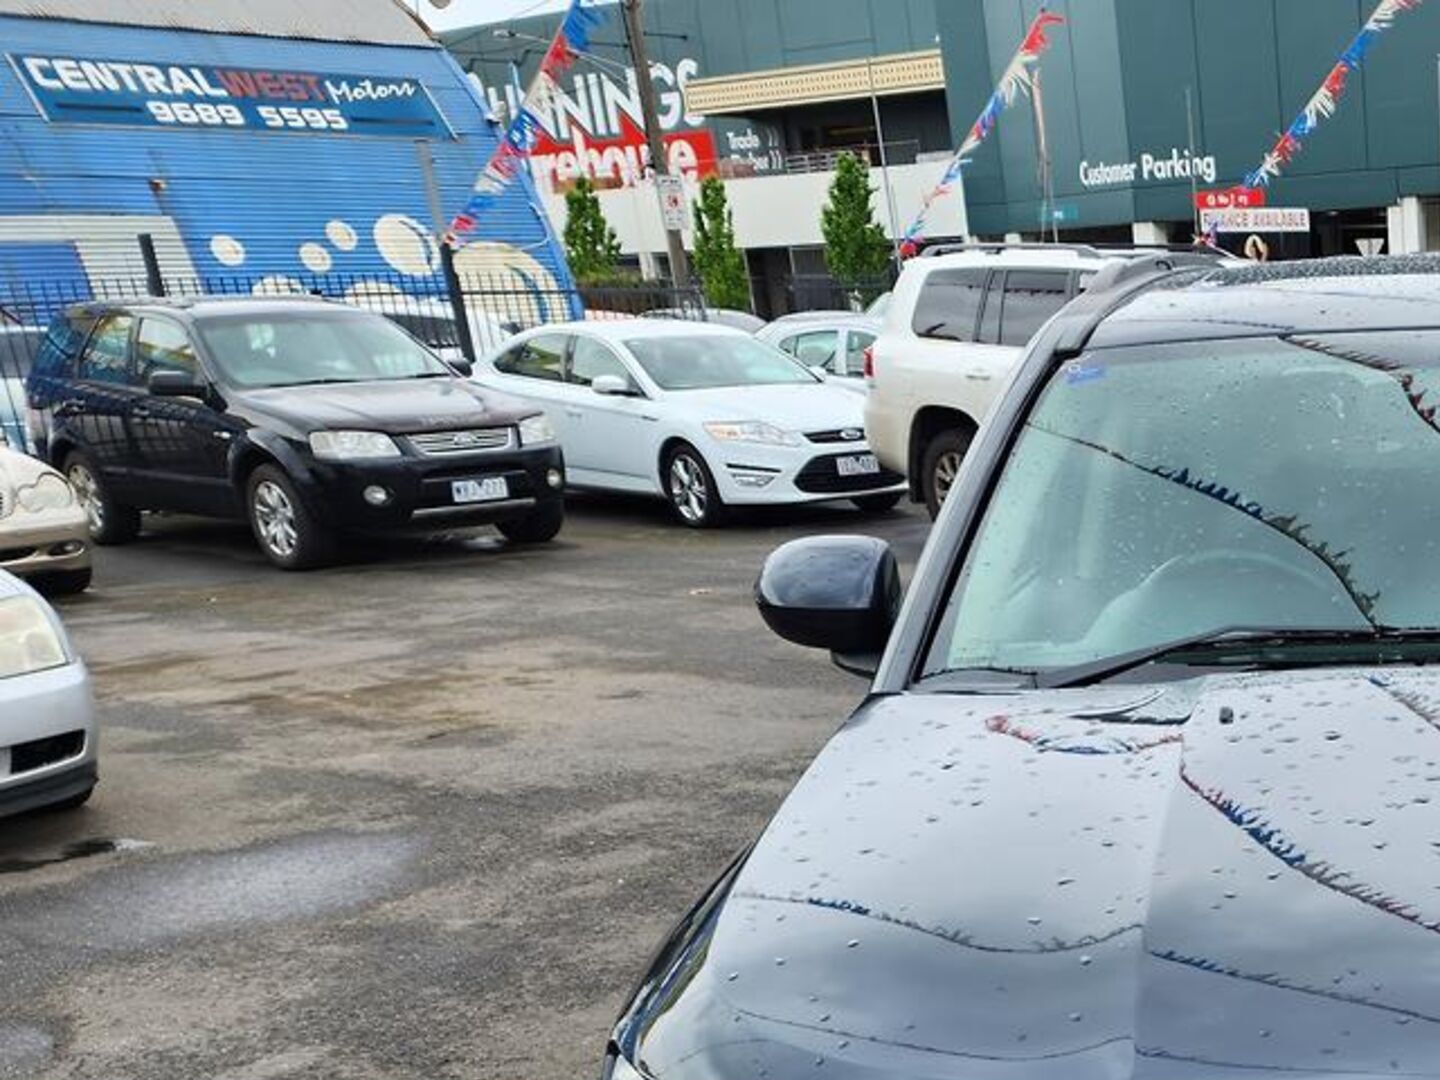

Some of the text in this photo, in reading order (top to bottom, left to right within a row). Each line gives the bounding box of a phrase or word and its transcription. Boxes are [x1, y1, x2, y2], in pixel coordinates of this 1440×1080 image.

[324, 79, 415, 104] Motors
[146, 101, 349, 130] 9689 5595
[1080, 147, 1216, 186] Customer Parking
[1203, 211, 1249, 227] FANCE
